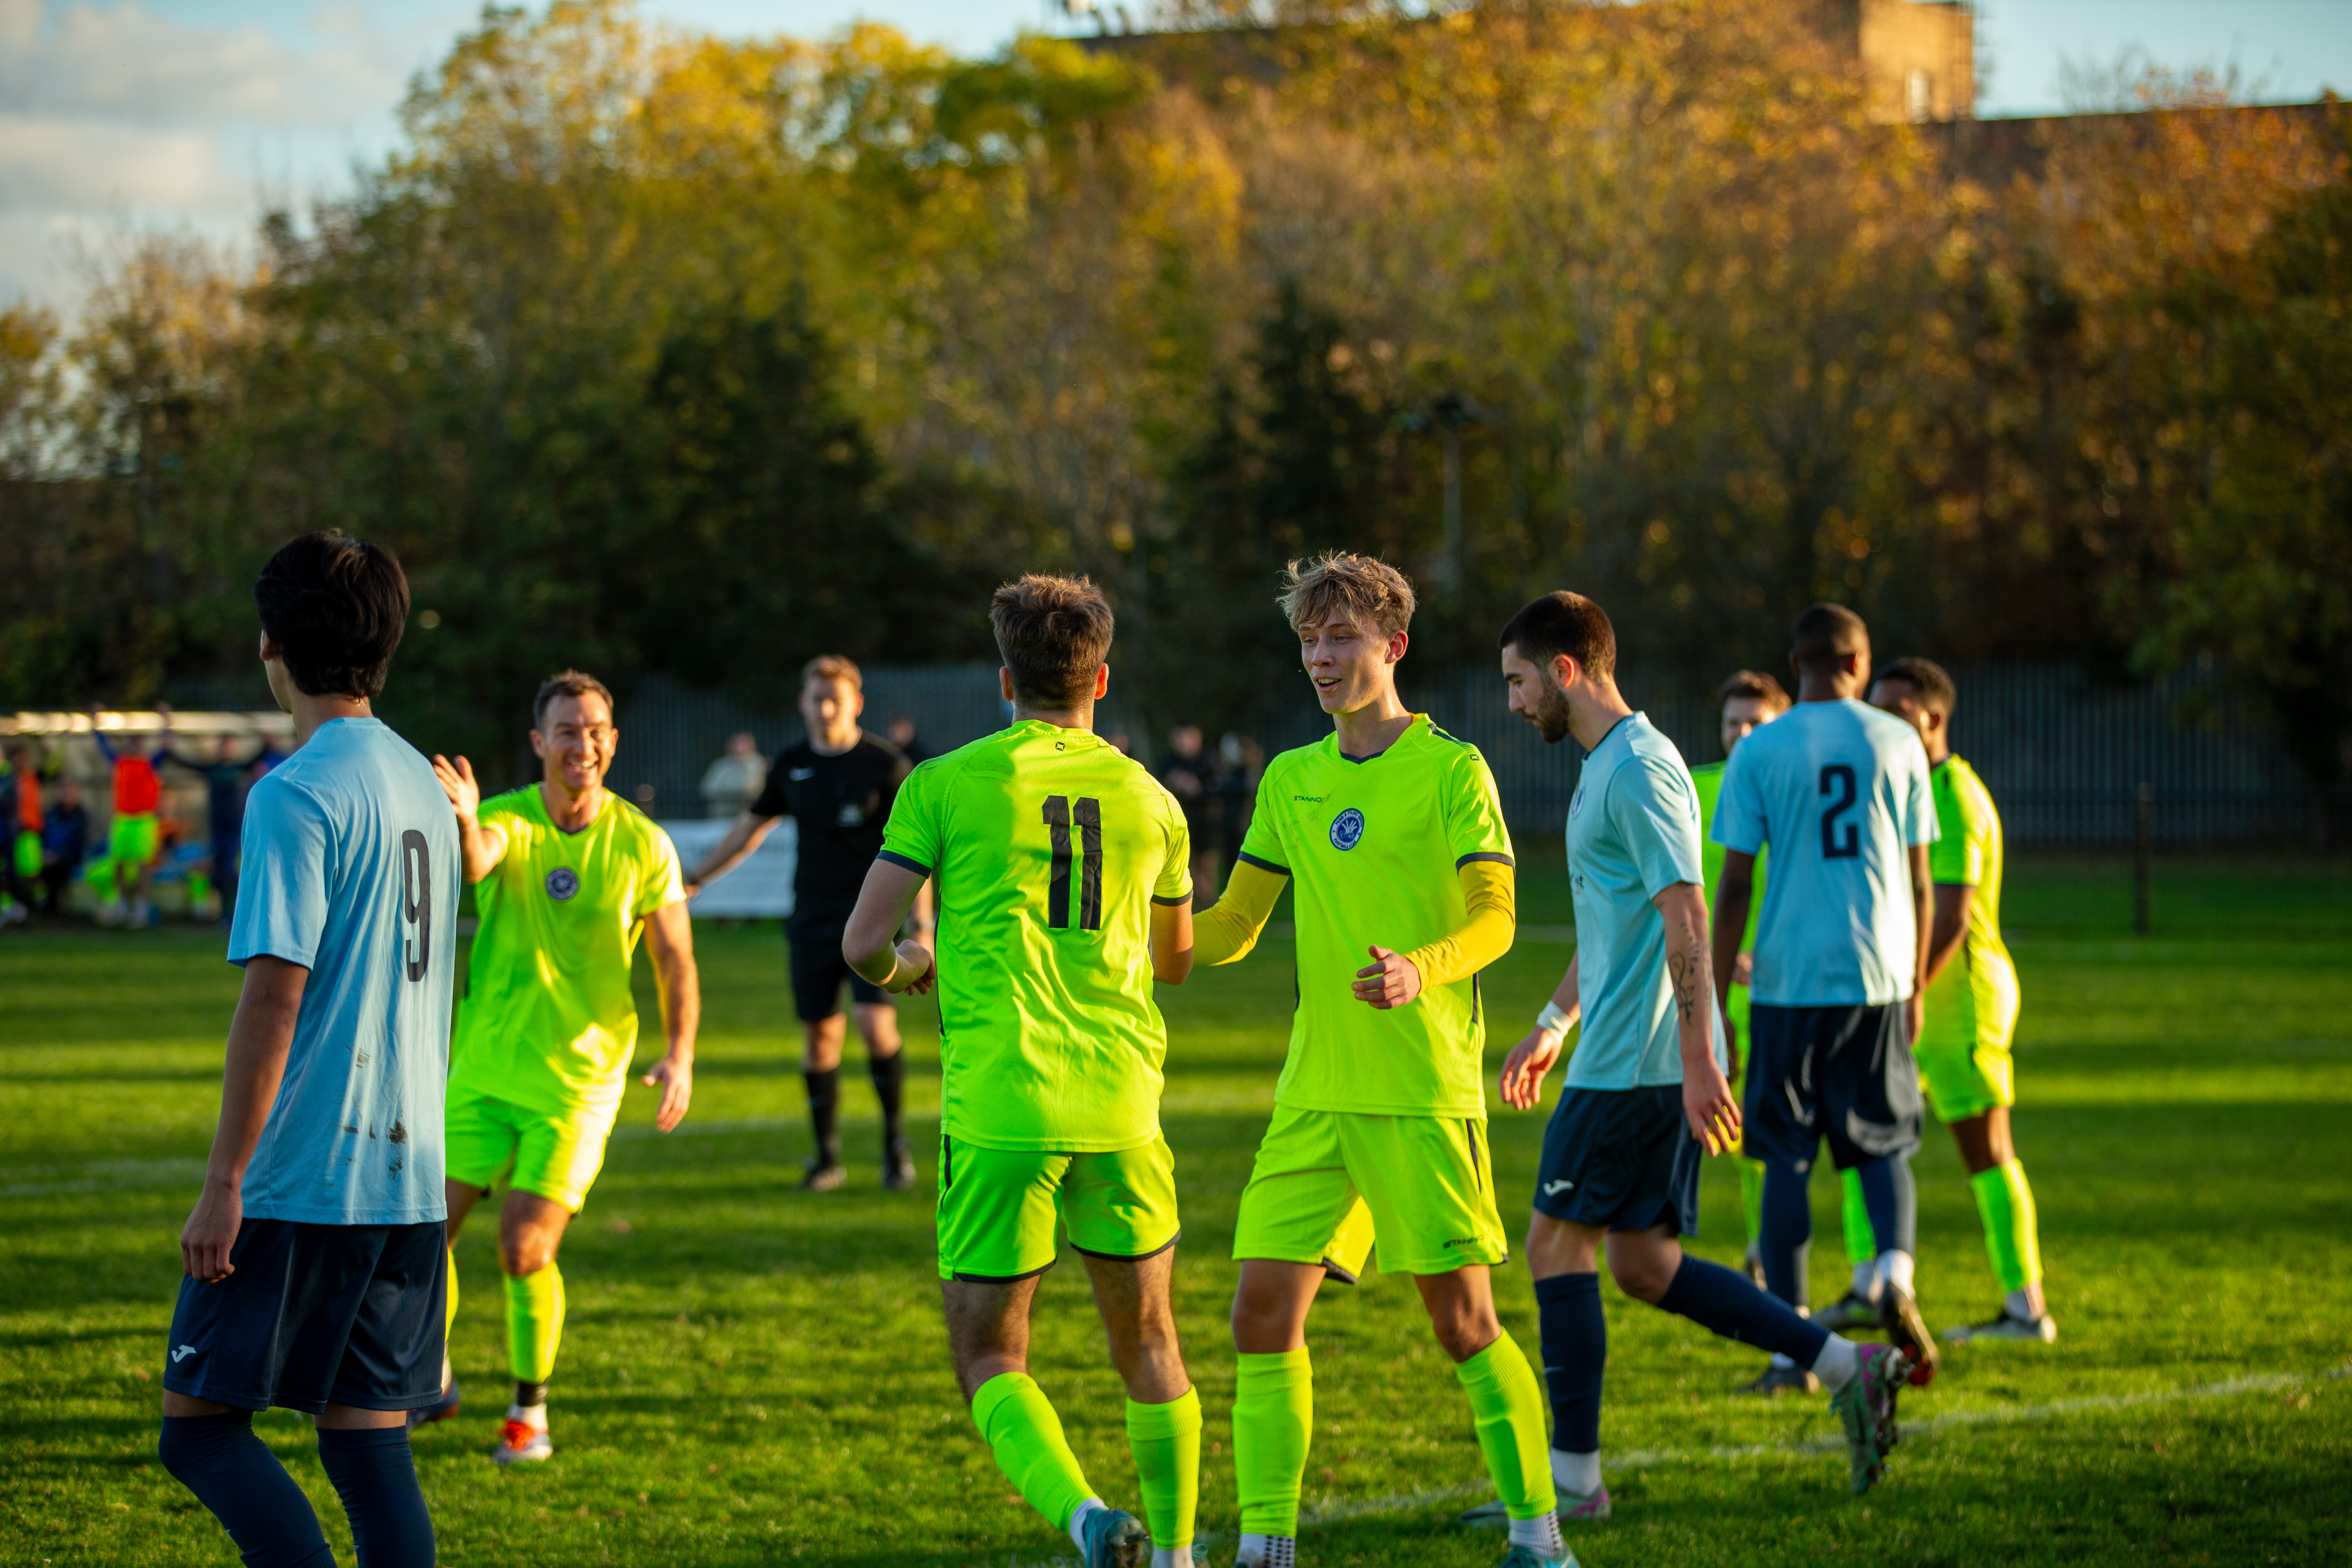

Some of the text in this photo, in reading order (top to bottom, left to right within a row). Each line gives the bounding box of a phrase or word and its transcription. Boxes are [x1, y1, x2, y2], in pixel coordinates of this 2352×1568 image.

[1334, 838, 1348, 848] FOOTBALL
[1335, 815, 1344, 825] PENN
[1820, 765, 1858, 858] 2
[402, 829, 431, 982] 9
[1042, 795, 1102, 930] 11
